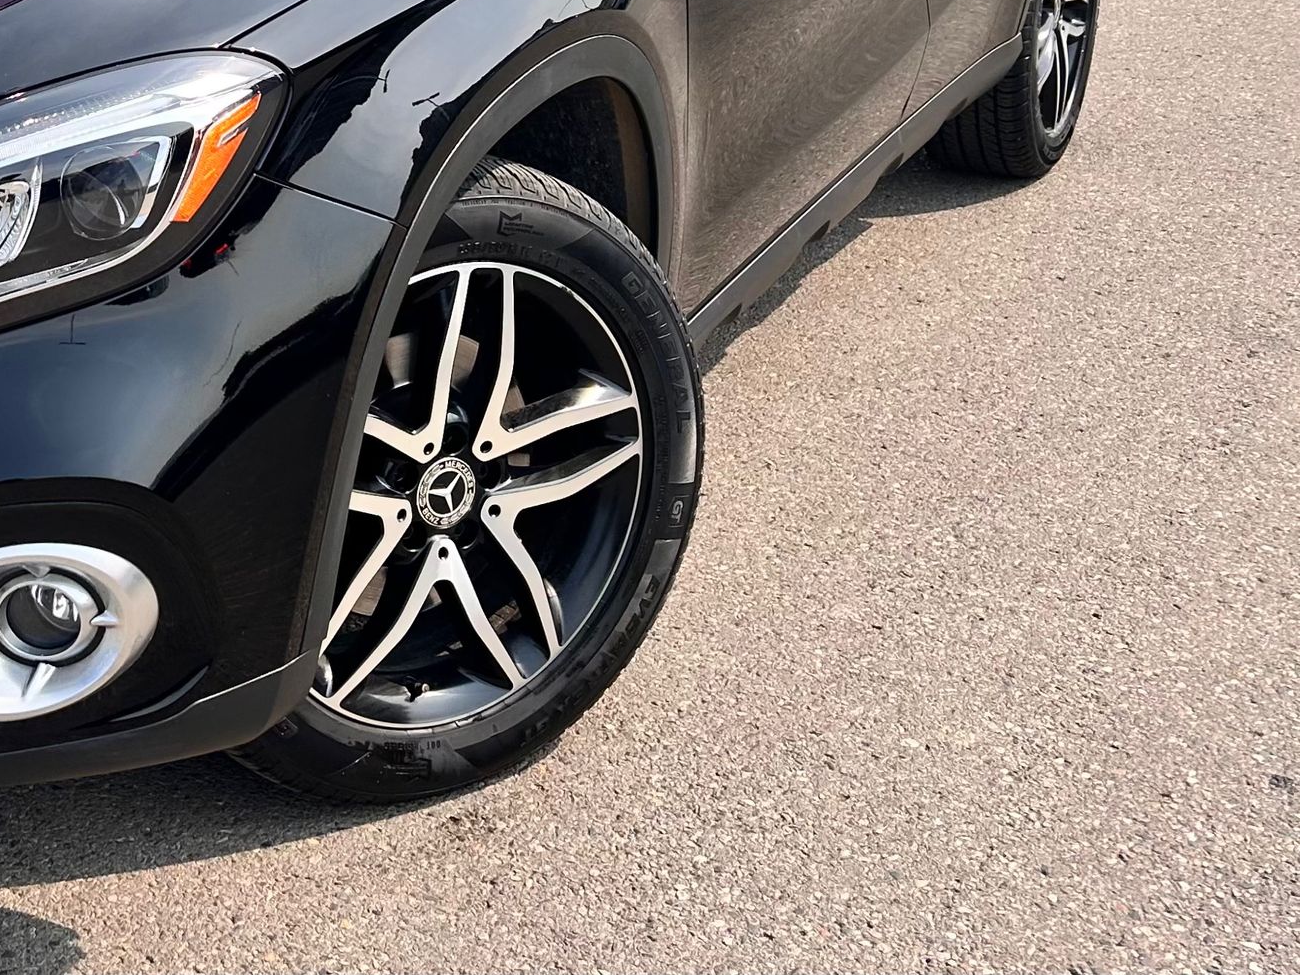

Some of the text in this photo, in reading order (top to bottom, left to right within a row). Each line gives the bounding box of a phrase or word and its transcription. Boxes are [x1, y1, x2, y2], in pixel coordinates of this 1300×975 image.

[621, 271, 692, 434] GENERAL
[444, 460, 475, 489] MERCEDES
[421, 506, 440, 525] BENZ
[671, 500, 684, 524] GT
